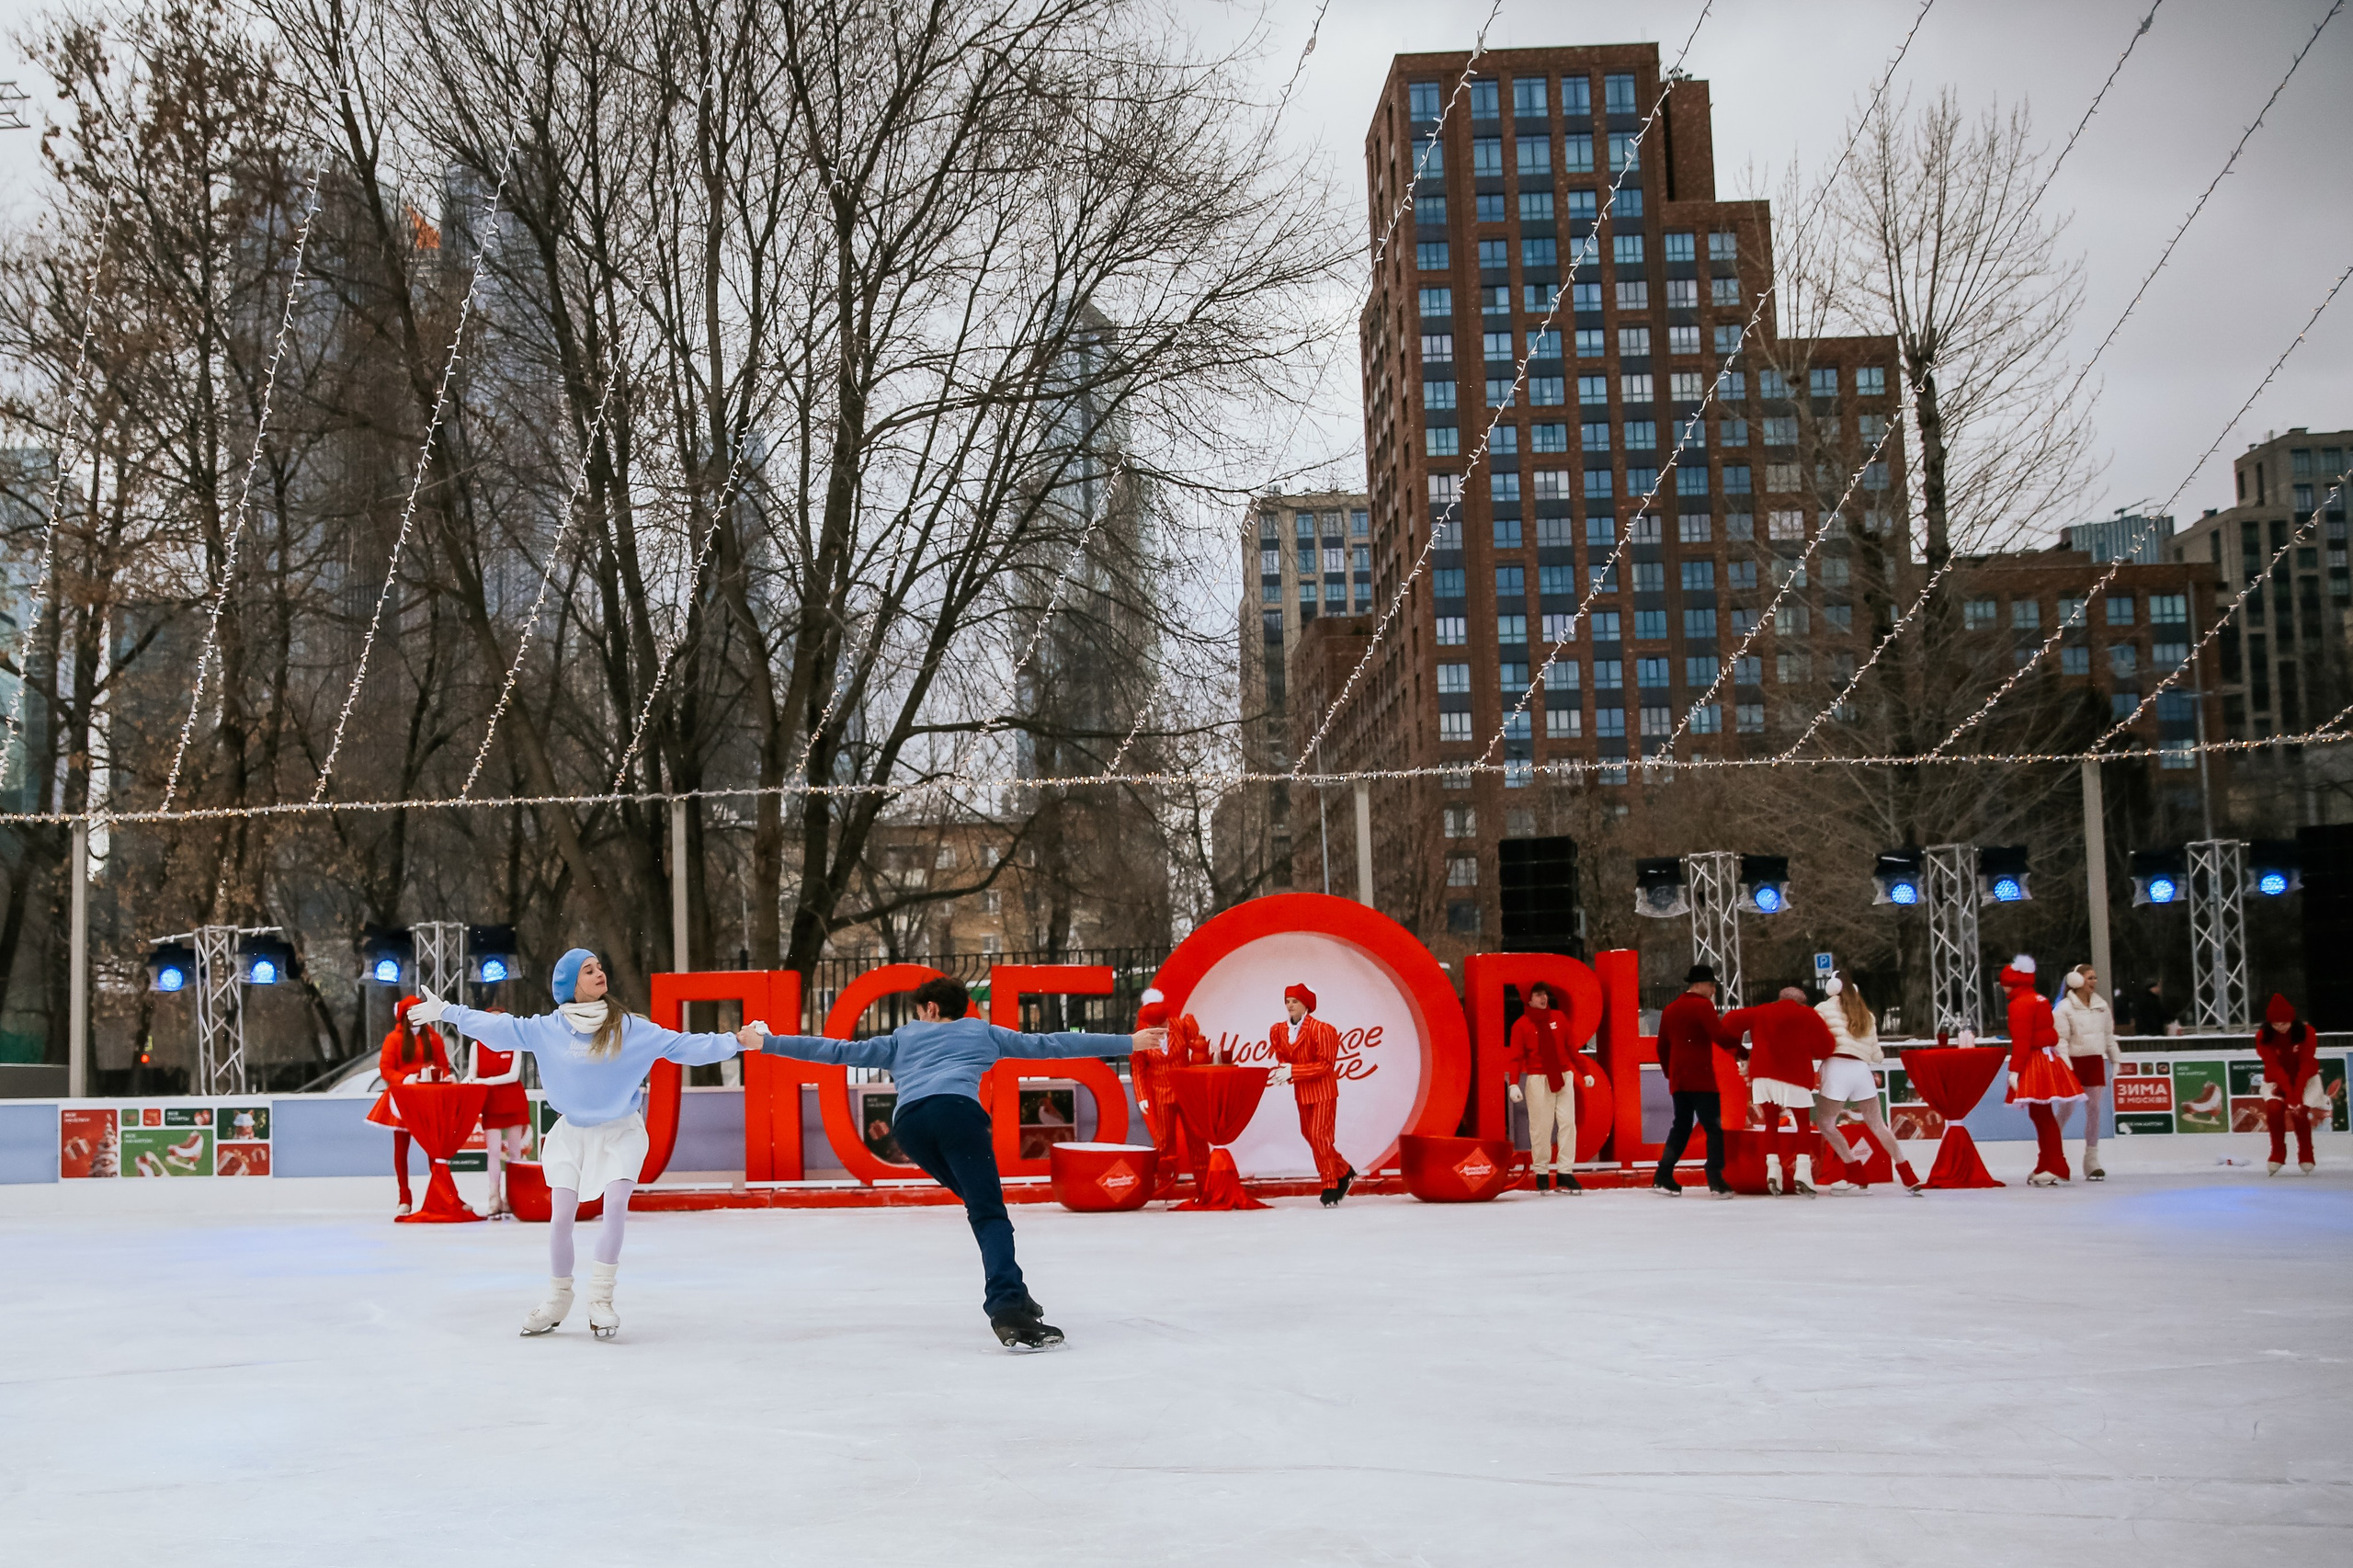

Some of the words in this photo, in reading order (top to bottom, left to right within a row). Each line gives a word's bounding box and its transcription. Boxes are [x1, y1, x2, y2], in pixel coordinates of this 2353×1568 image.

[2117, 1084, 2168, 1096] ЗИМА
[2117, 1096, 2125, 1105] В
[2127, 1096, 2168, 1105] МОСКВЕ
